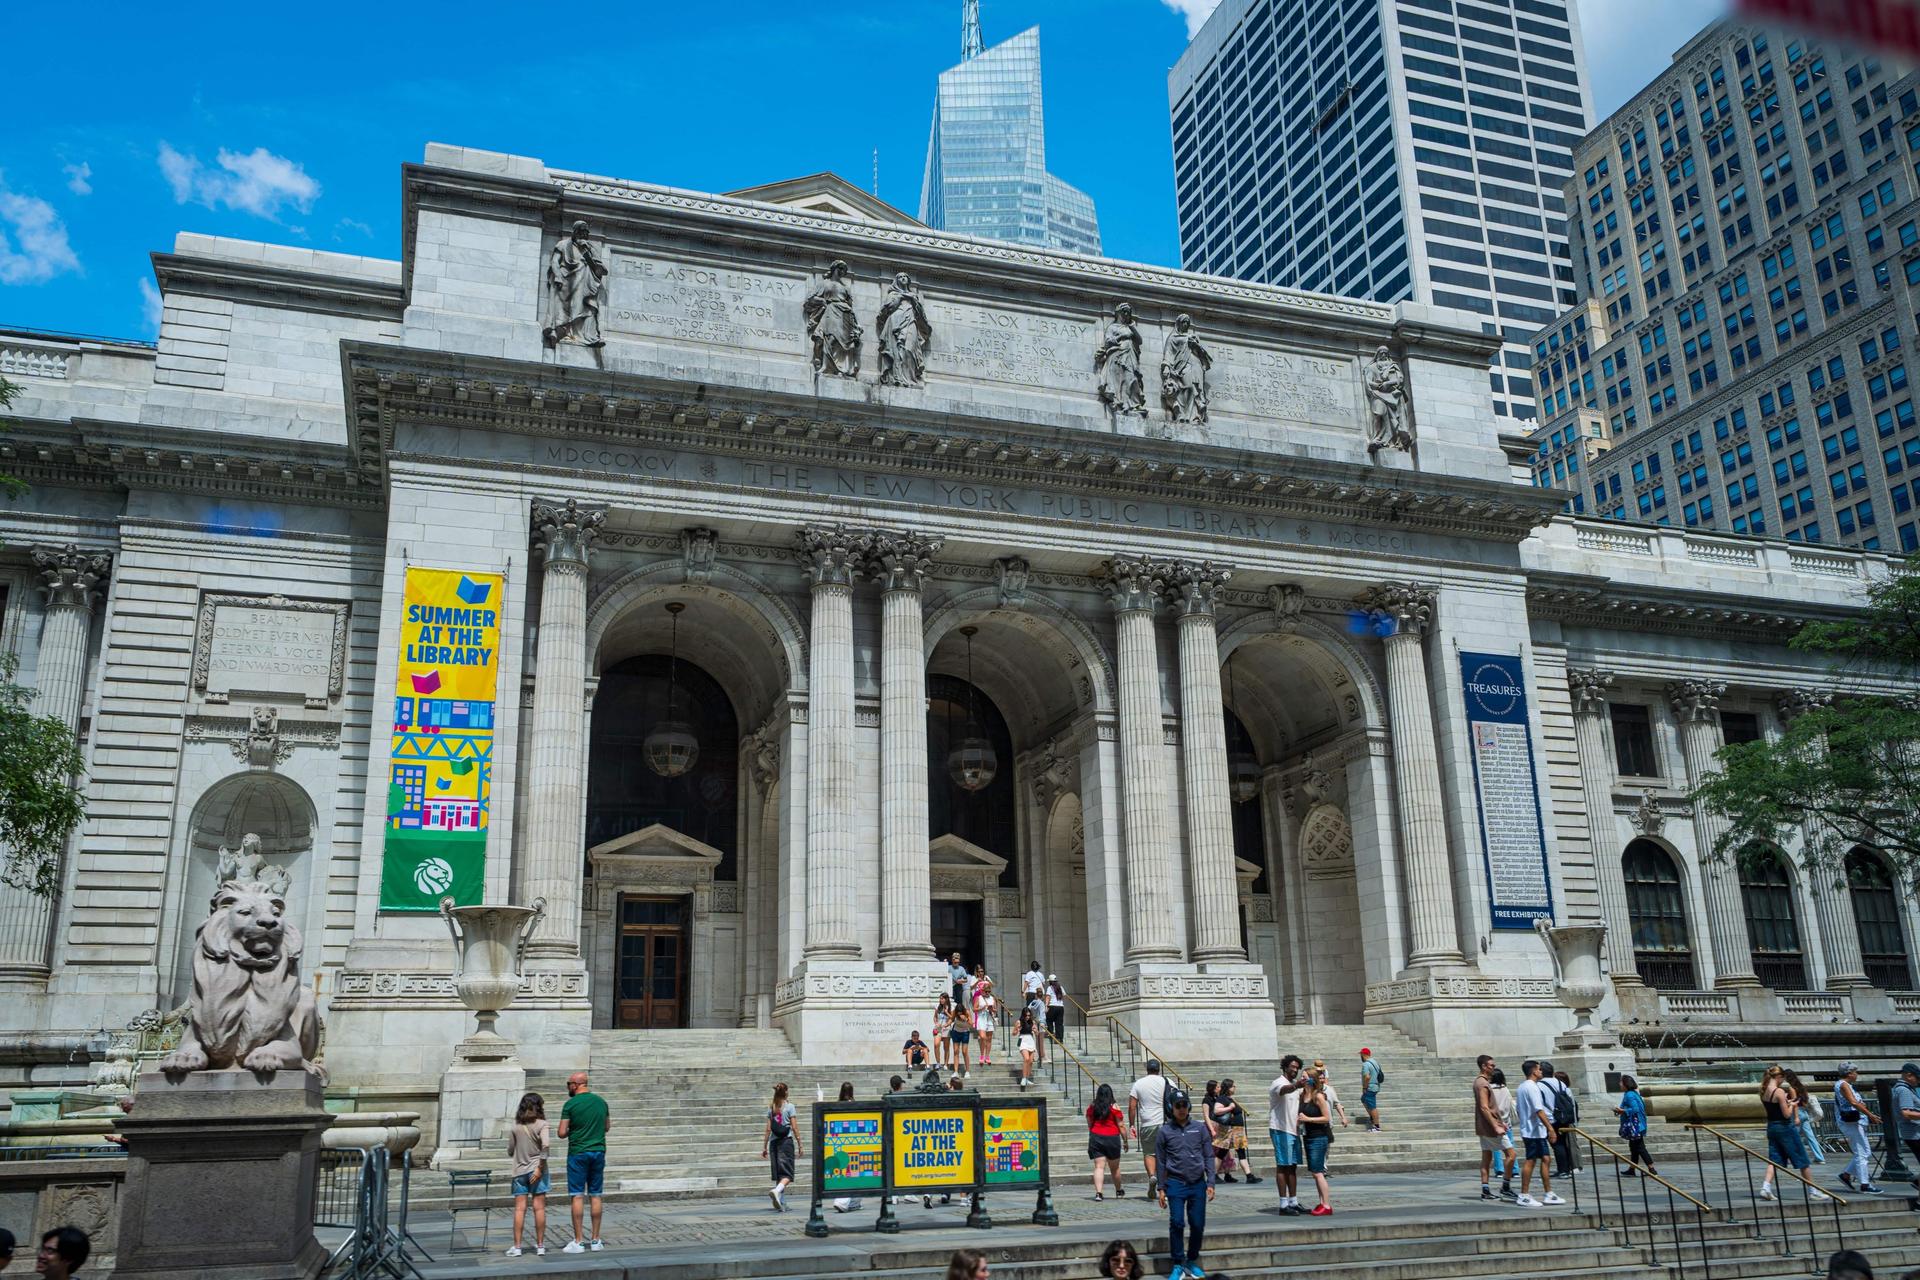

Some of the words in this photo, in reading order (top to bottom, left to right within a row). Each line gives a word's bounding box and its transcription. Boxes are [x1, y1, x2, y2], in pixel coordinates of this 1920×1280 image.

[621, 260, 654, 277] THE
[664, 267, 718, 286] ASTOR
[727, 274, 796, 296] LIBRARY
[673, 286, 721, 300] FOUNDED
[732, 294, 745, 304] BY
[643, 292, 679, 305] JOHN
[684, 297, 726, 311] JACOB
[732, 304, 772, 318] ASTOR
[684, 308, 705, 320] FOR
[710, 312, 731, 322] THE
[932, 305, 963, 321] THE
[970, 310, 1019, 330] LENOX
[1027, 318, 1087, 338] LIBRARY
[616, 311, 689, 327] ADVANCEMENT
[690, 320, 704, 329] OF
[708, 323, 741, 335] USEFUL
[744, 328, 800, 342] KNOWLEDGE
[980, 329, 1022, 343] FOUNDED
[954, 346, 1004, 360] DEDICATED
[1010, 353, 1022, 362] TO
[969, 338, 1007, 351] JAMES
[1016, 344, 1056, 358] LENOX
[932, 353, 990, 367] LITERATURE
[998, 362, 1015, 371] AND
[1022, 365, 1038, 374] THE
[1044, 368, 1064, 378] FINE
[1070, 372, 1090, 381] ARTS
[1208, 346, 1234, 361] THE
[1246, 351, 1293, 369] TILDEN
[1303, 359, 1344, 376] TRUST
[1251, 368, 1289, 380] FOUNDED
[1224, 374, 1262, 387] SAMUEL
[1267, 379, 1298, 392] JONES
[1234, 385, 1258, 395] SERVE
[1210, 391, 1245, 402] SCIENCE
[1250, 396, 1266, 406] AND
[548, 446, 674, 471] MDCCCXCV
[744, 462, 812, 490] THE
[834, 472, 912, 498] NEW
[940, 484, 1017, 510] YORK
[1041, 495, 1139, 523] PUBLIC
[1166, 506, 1276, 538] LIBRARY
[252, 614, 301, 625] BEAUTY
[408, 604, 496, 628] SUMMER
[215, 628, 242, 638] OLD
[246, 630, 267, 641] YET
[270, 630, 299, 642] EVER
[303, 632, 332, 644] NEW
[418, 626, 442, 644] AT
[448, 628, 484, 646] THE
[222, 643, 280, 658] ETERNAL
[284, 648, 323, 660] VOICE
[407, 643, 493, 666] LIBRARY
[212, 659, 238, 670] AND
[240, 660, 290, 673] INWARD
[292, 664, 329, 675] WORD
[1467, 682, 1522, 697] TREASURES
[1512, 911, 1550, 919] EXHIBITION
[902, 1118, 964, 1134] SUMMER
[912, 1135, 927, 1150] AT
[931, 1134, 956, 1150] THE
[904, 1150, 964, 1168] LIBRARY
